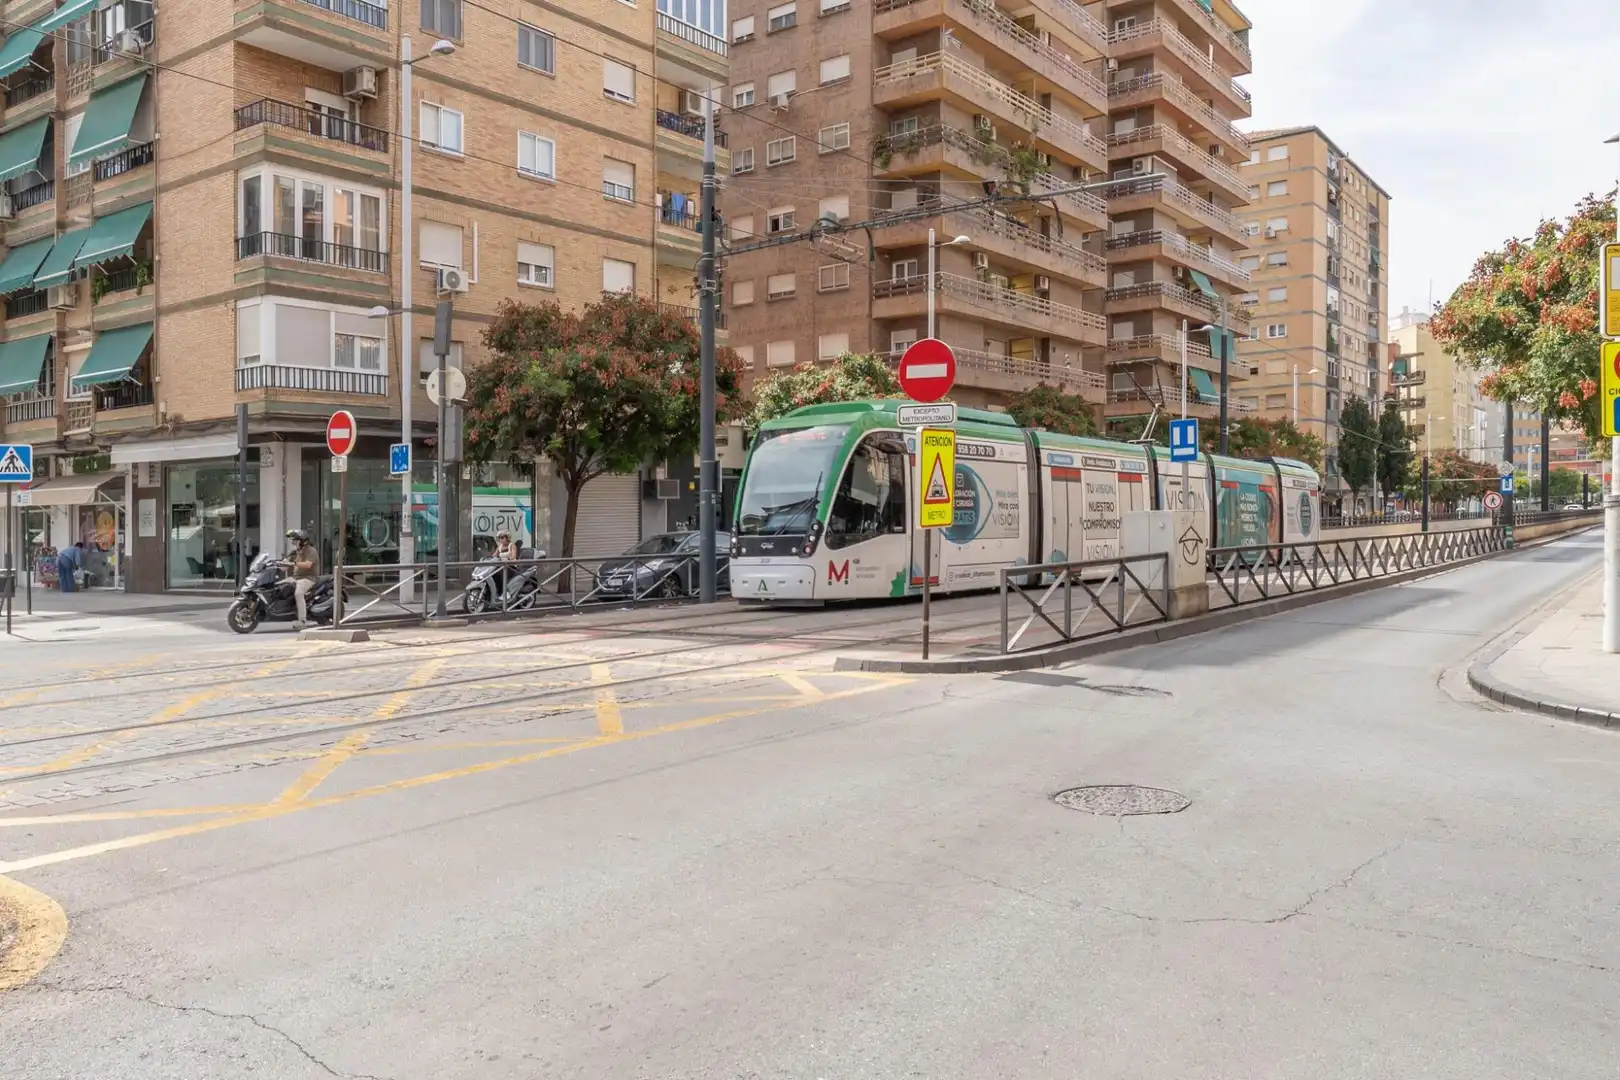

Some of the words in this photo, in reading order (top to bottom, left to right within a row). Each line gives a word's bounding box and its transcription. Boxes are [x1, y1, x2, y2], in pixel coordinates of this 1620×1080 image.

[925, 434, 952, 446] ATENCIÓN
[969, 446, 977, 454] 20
[977, 446, 985, 455] 70
[1086, 483, 1094, 494] TU
[1089, 502, 1114, 512] NUESTRO
[928, 510, 945, 520] METRO
[954, 511, 974, 520] RATIS
[992, 510, 1019, 525] VISIÓN
[1083, 519, 1120, 530] COMPROMISO
[1086, 540, 1115, 560] VISIÓN
[828, 559, 849, 585] M
